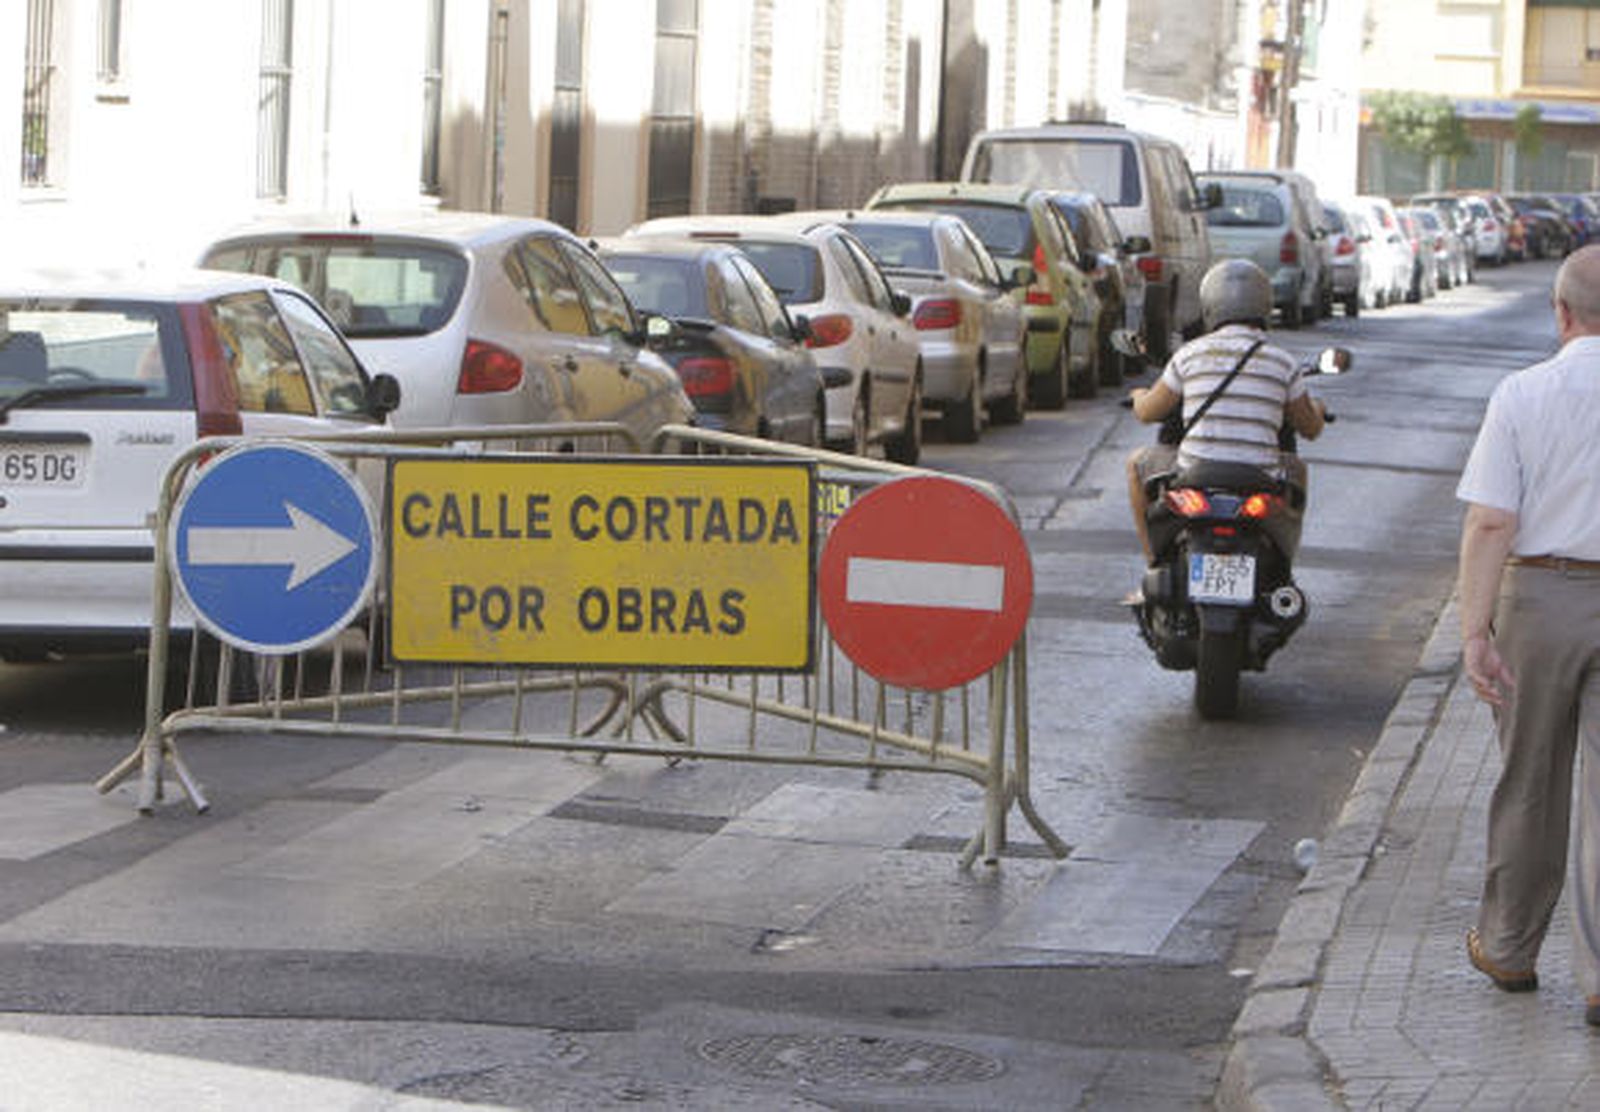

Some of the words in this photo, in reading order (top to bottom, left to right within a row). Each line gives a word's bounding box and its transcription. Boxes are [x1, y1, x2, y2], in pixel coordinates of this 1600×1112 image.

[402, 493, 552, 538] CALLE
[570, 494, 800, 544] CORTADA
[451, 584, 545, 631] POR
[578, 586, 746, 636] OBRAS
